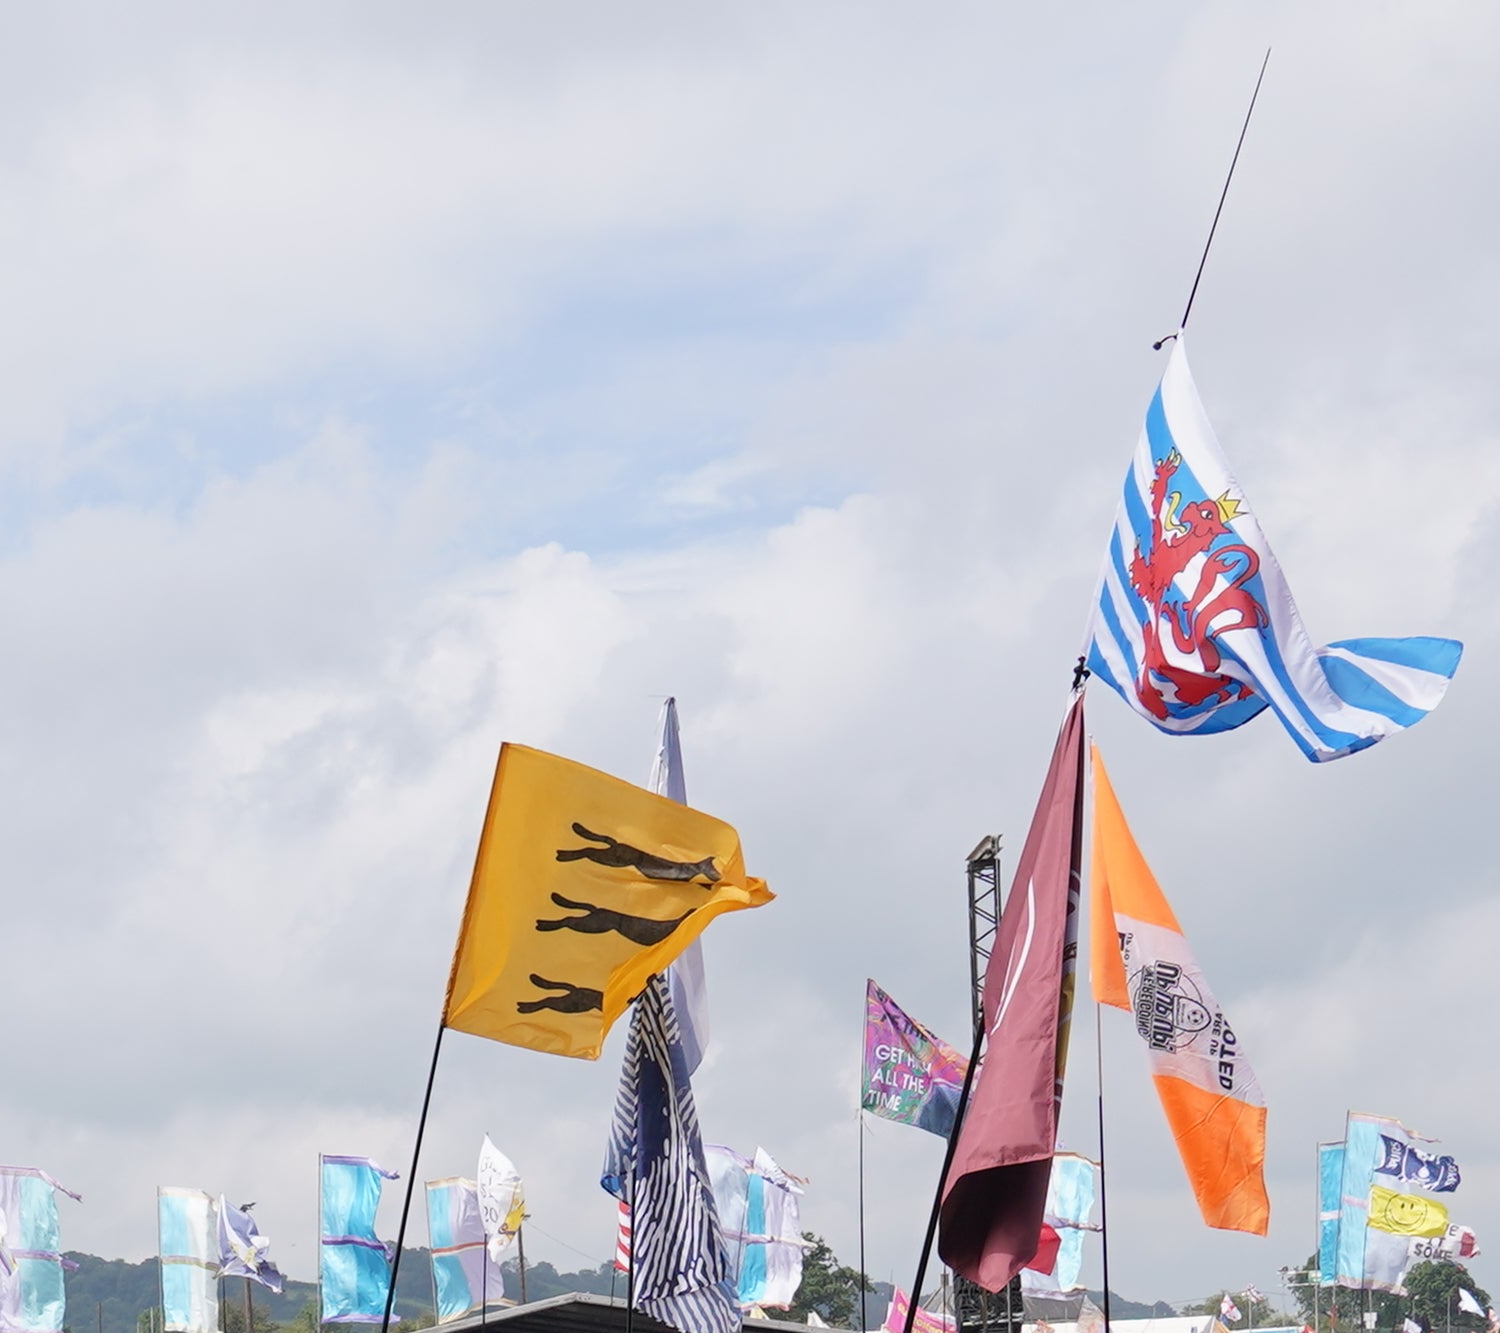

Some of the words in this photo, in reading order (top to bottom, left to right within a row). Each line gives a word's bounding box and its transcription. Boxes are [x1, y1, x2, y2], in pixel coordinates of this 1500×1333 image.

[875, 1044, 905, 1065] GET
[871, 1067, 899, 1088] ALL
[902, 1073, 925, 1095] THE
[868, 1089, 902, 1112] TIME
